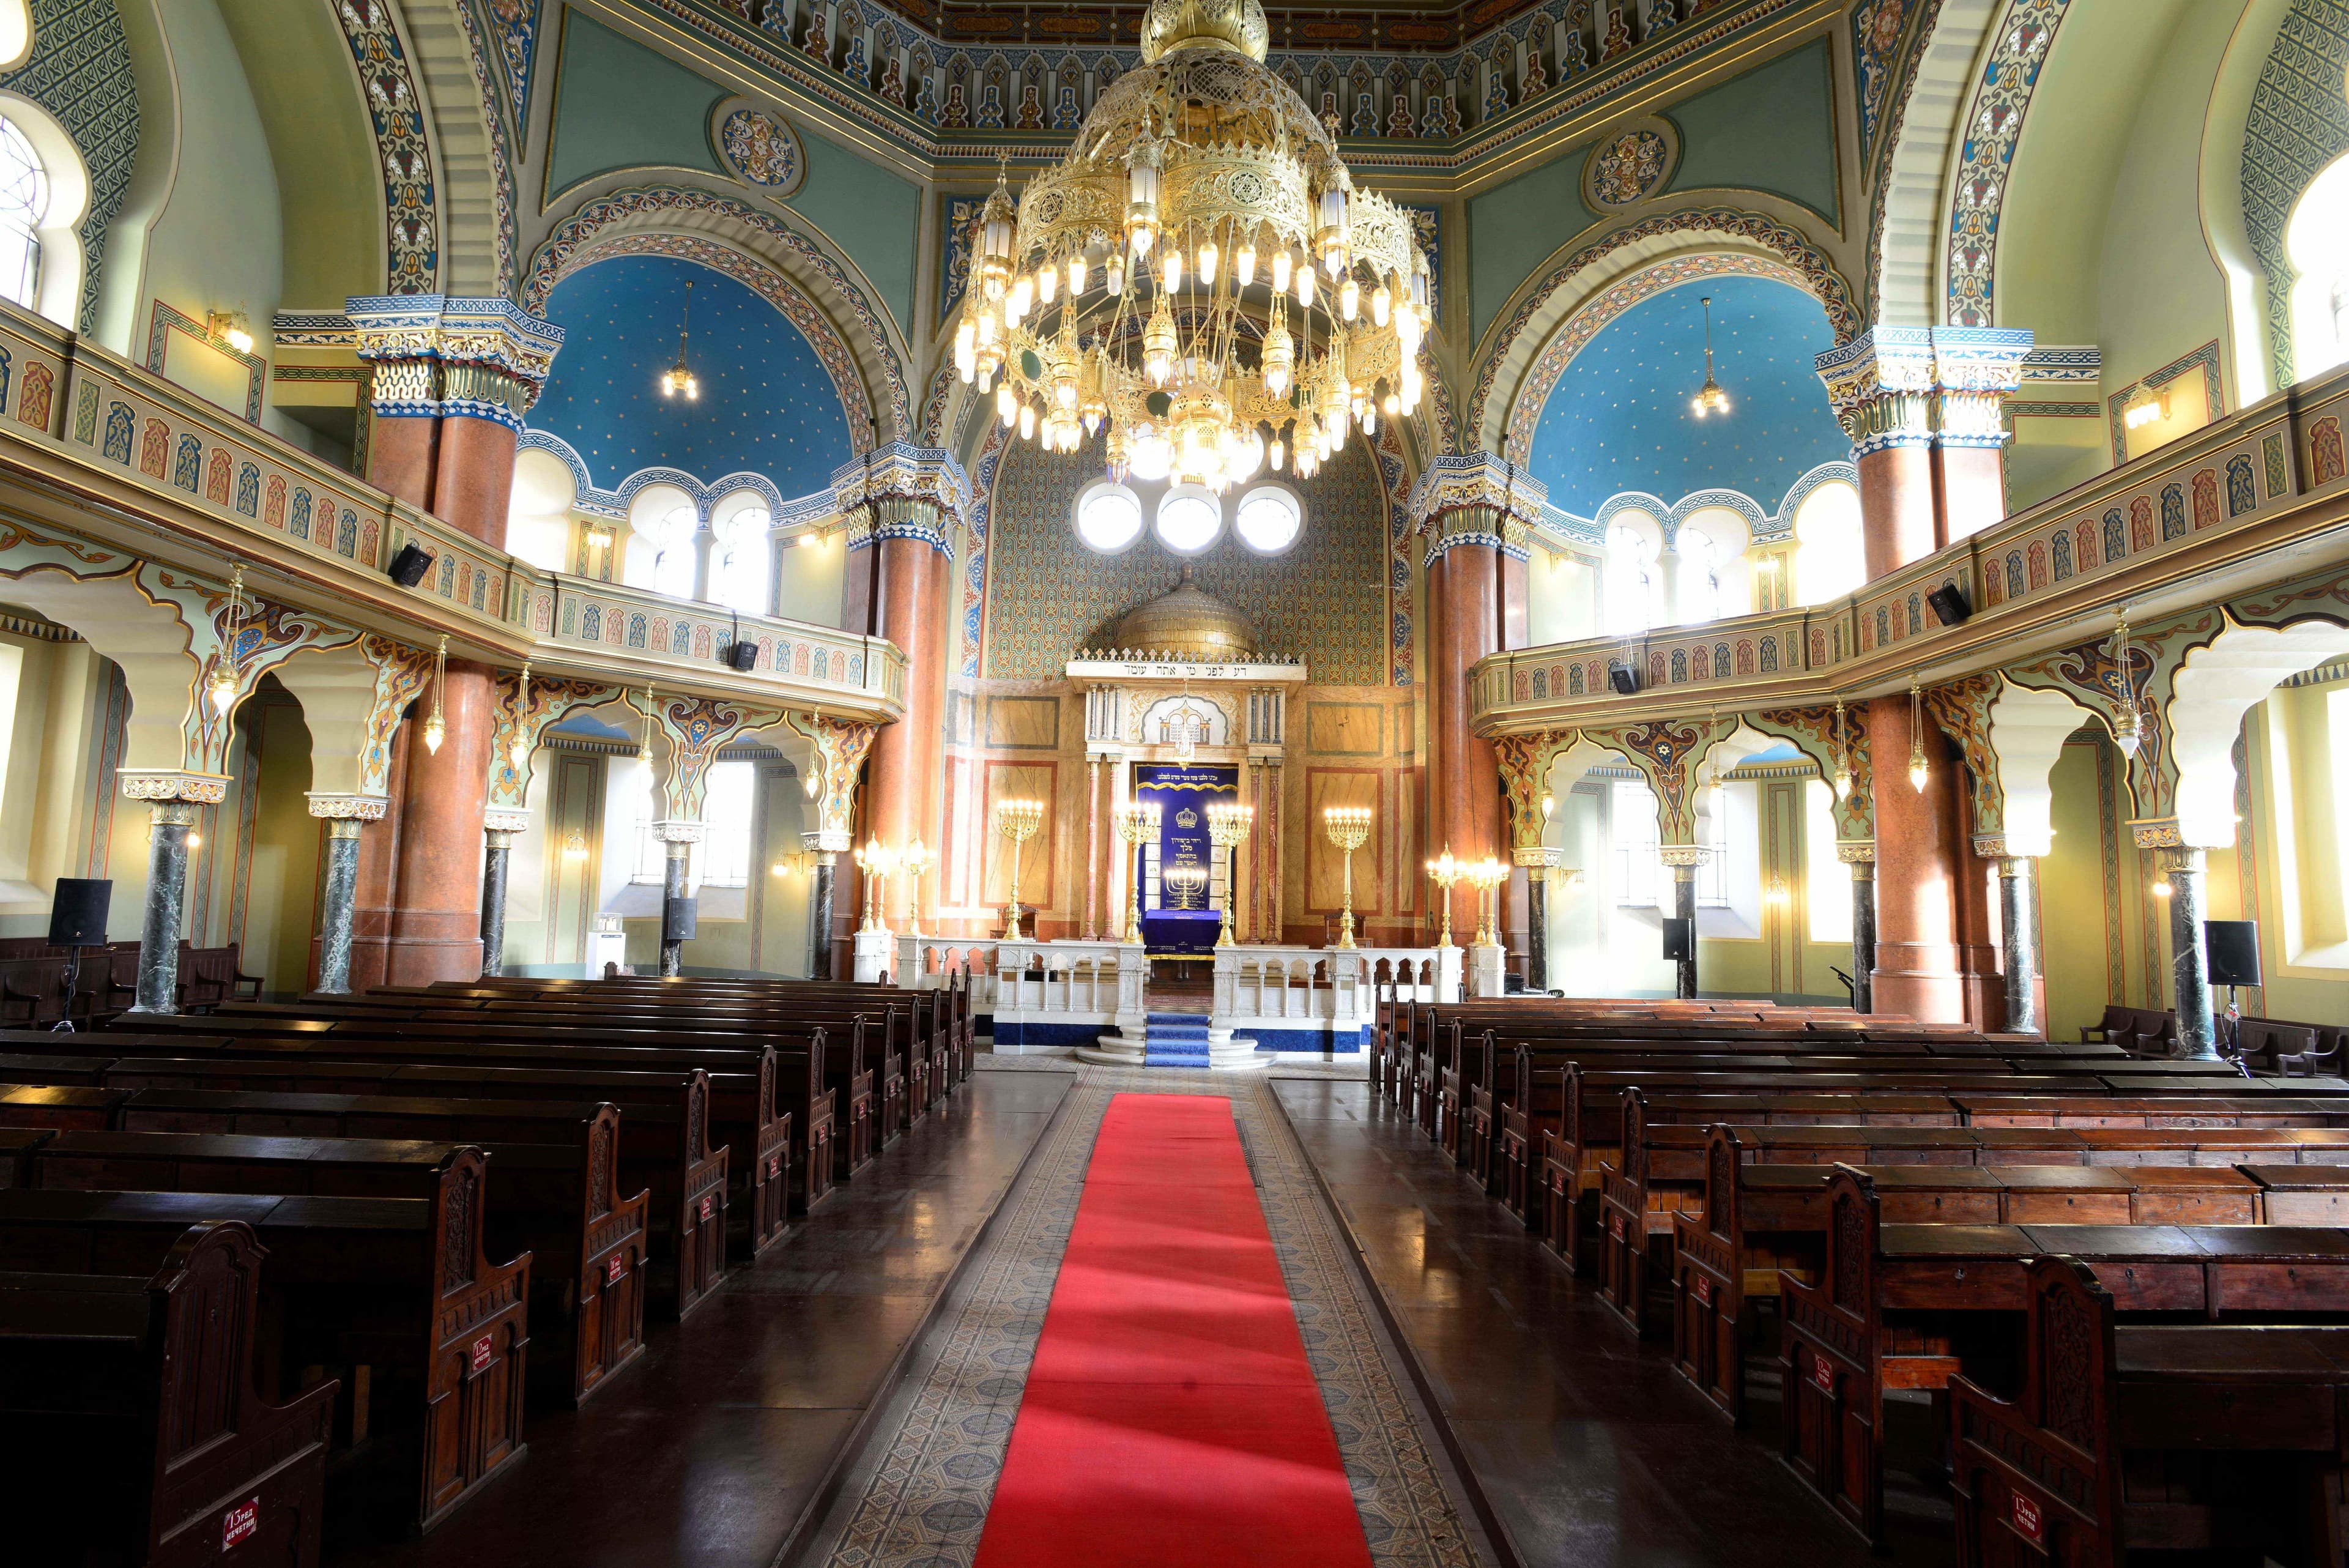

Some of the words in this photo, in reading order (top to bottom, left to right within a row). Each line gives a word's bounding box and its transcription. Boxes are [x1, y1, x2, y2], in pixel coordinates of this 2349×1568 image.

[1124, 664, 1147, 675] עומד
[1156, 666, 1176, 675] אתה
[1186, 666, 1196, 675] מי
[1205, 666, 1225, 677] לפני
[1234, 667, 1247, 677] דע
[1180, 842, 1193, 852] מלך
[2016, 1497, 2025, 1514] 13
[230, 1509, 241, 1529] 13
[226, 1517, 254, 1541] НЕЧЕТНИ
